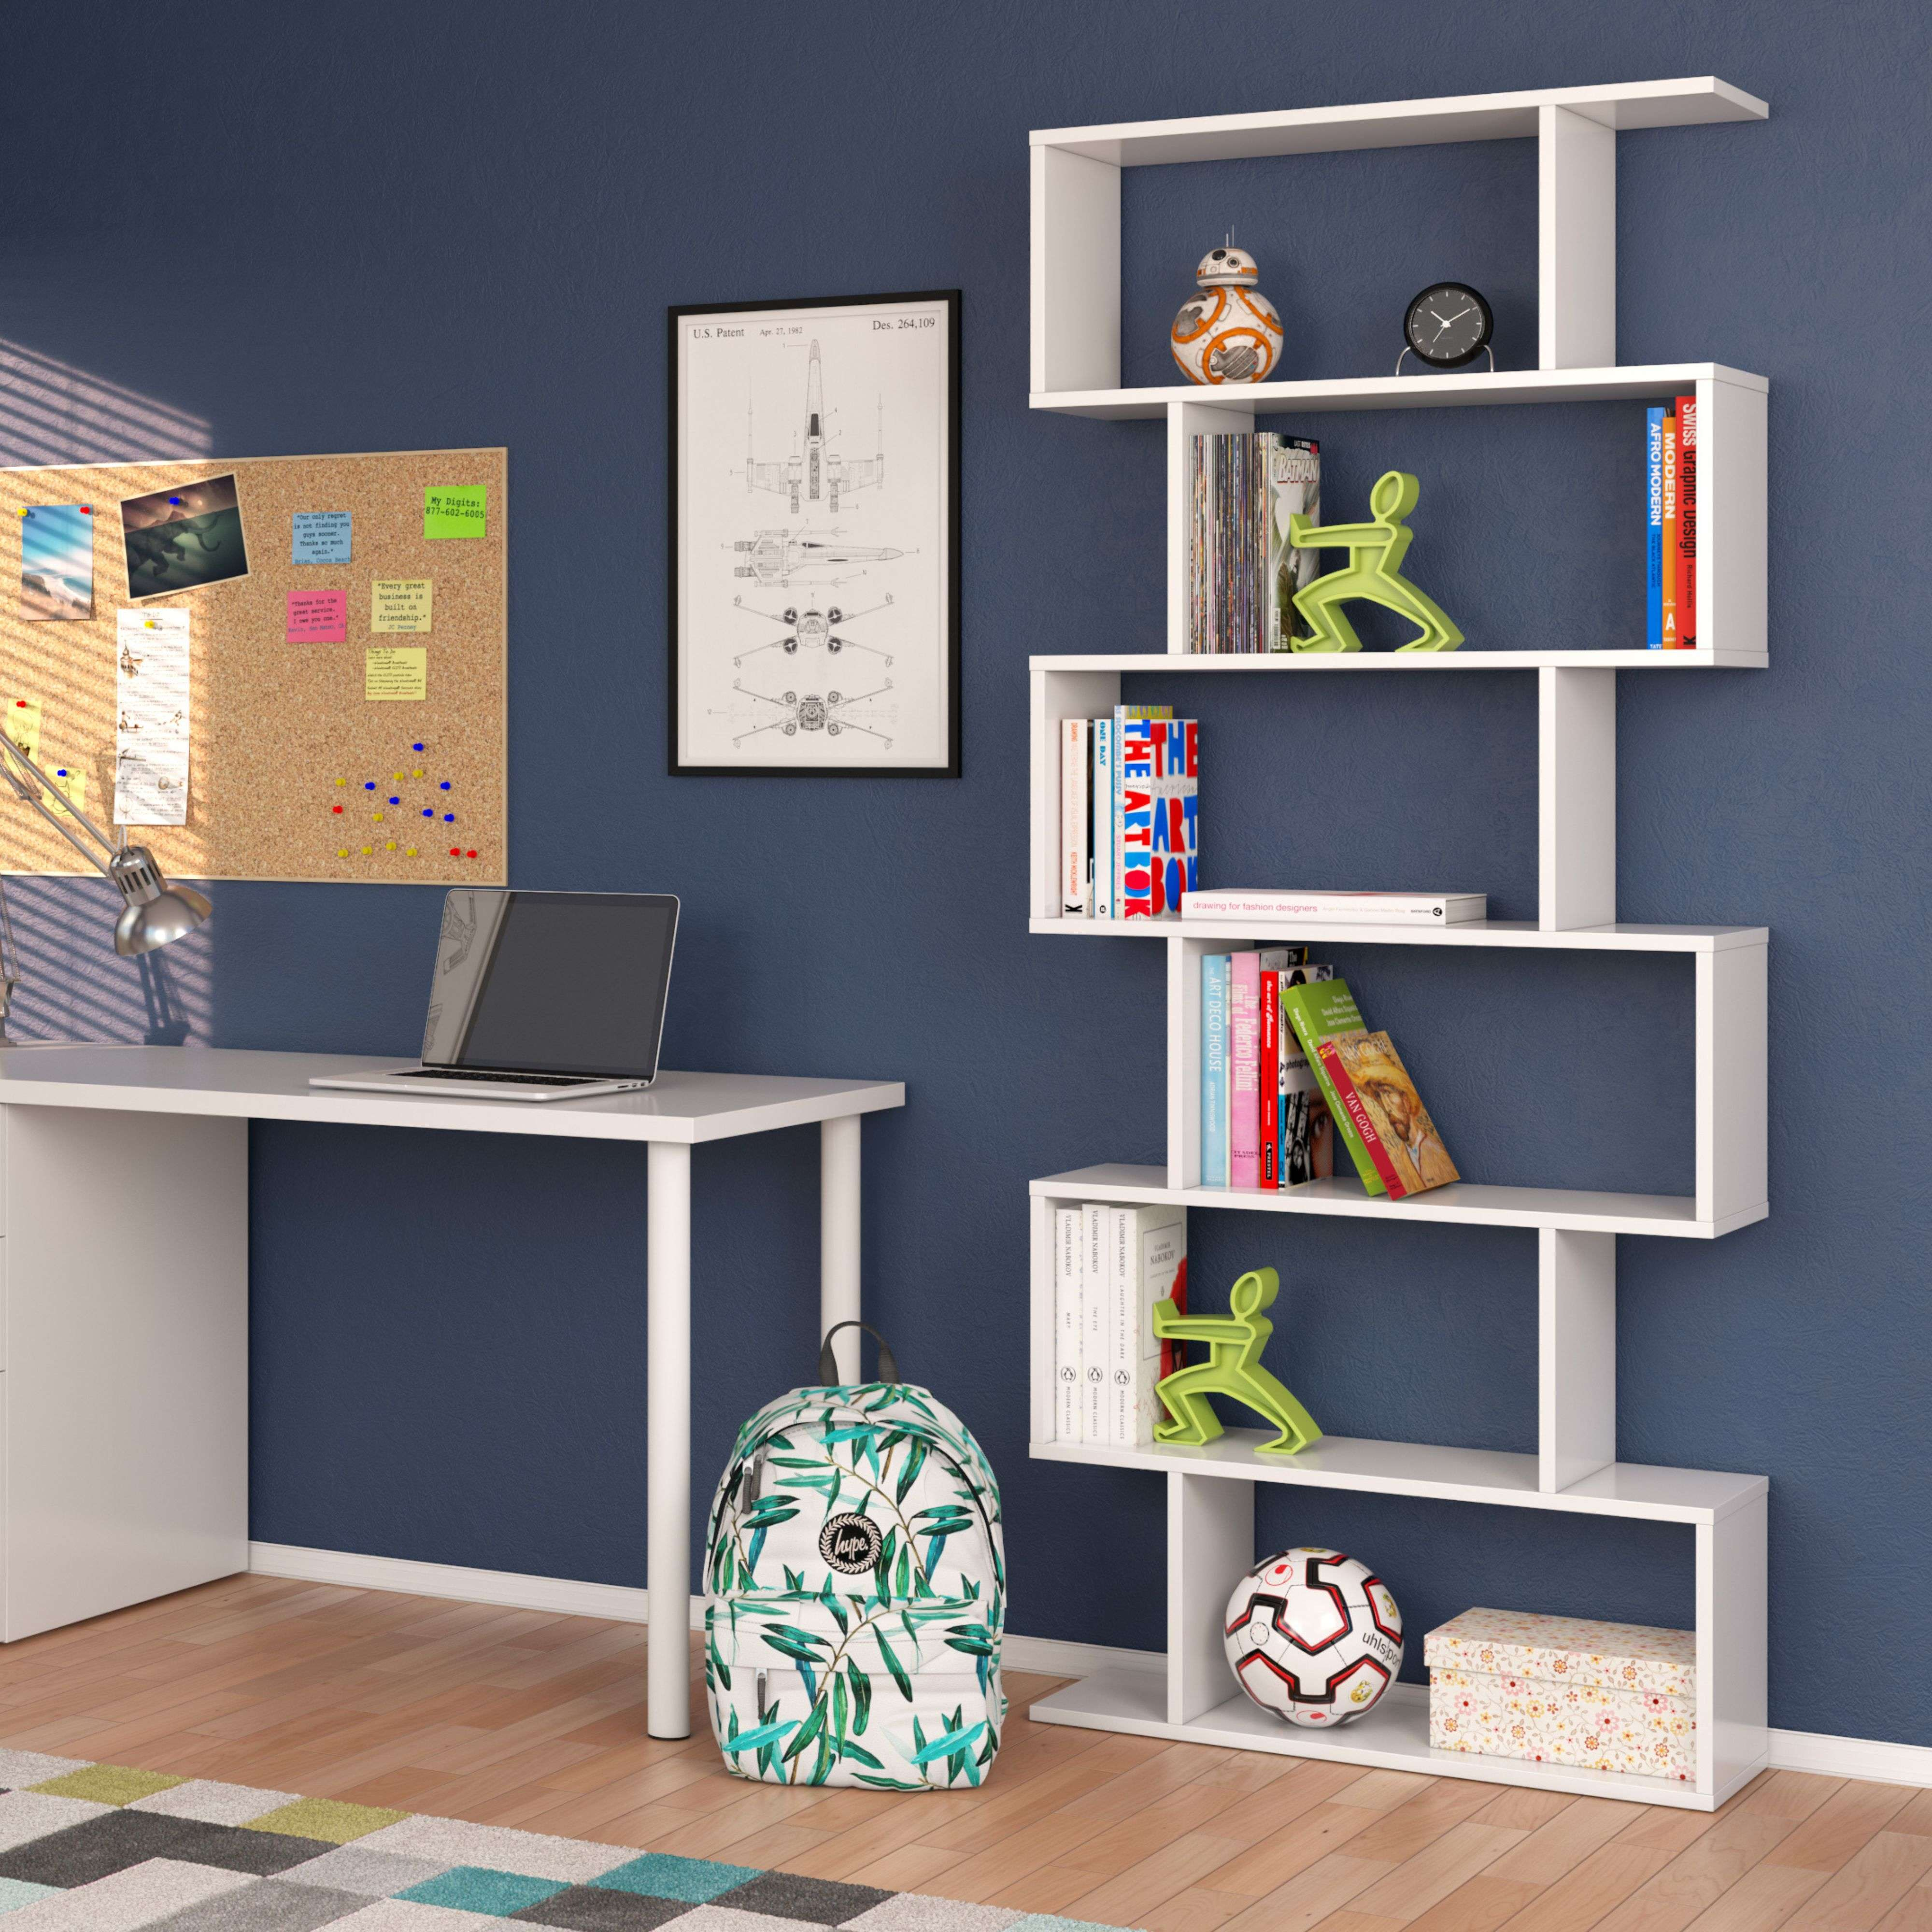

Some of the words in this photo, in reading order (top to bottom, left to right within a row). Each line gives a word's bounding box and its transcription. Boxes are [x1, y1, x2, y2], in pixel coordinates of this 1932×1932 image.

[694, 328, 712, 339] U.S.
[717, 327, 744, 338] Patent
[873, 320, 893, 330] Des.
[898, 317, 935, 329] 264,109
[1650, 423, 1662, 462] AFRO
[1278, 453, 1318, 482] BATMAN
[1664, 432, 1676, 519] MODERN
[431, 497, 441, 506] My
[446, 497, 479, 508] Digits:
[1650, 464, 1662, 526] MODERN
[426, 507, 484, 518] 877-602-6005
[405, 582, 426, 590] great
[1665, 613, 1676, 630] A
[1125, 719, 1151, 778] THE
[1150, 721, 1198, 778] THE
[1125, 790, 1151, 846] ART
[1152, 795, 1198, 853] ART
[1125, 852, 1151, 918] BOOK
[1193, 901, 1226, 911] drawing
[1229, 902, 1240, 910] for
[1243, 902, 1273, 911] fashion
[1276, 904, 1318, 913] designers
[1209, 977, 1222, 997] ART
[1232, 984, 1248, 1004] Films
[1209, 1000, 1222, 1031] DECO
[1266, 1005, 1273, 1013] of
[1293, 1008, 1302, 1022] Diego
[1299, 1021, 1308, 1036] Rivera
[1209, 1035, 1222, 1072] HOUSE
[1235, 1018, 1257, 1059] Federico
[1235, 1060, 1258, 1091] Fellini
[1345, 1092, 1362, 1113] VAN
[1356, 1114, 1377, 1143] GOGH
[1151, 1250, 1175, 1265] NABOKOV
[835, 1528, 868, 1560] hype.
[1363, 1633, 1401, 1667] uhlspor
